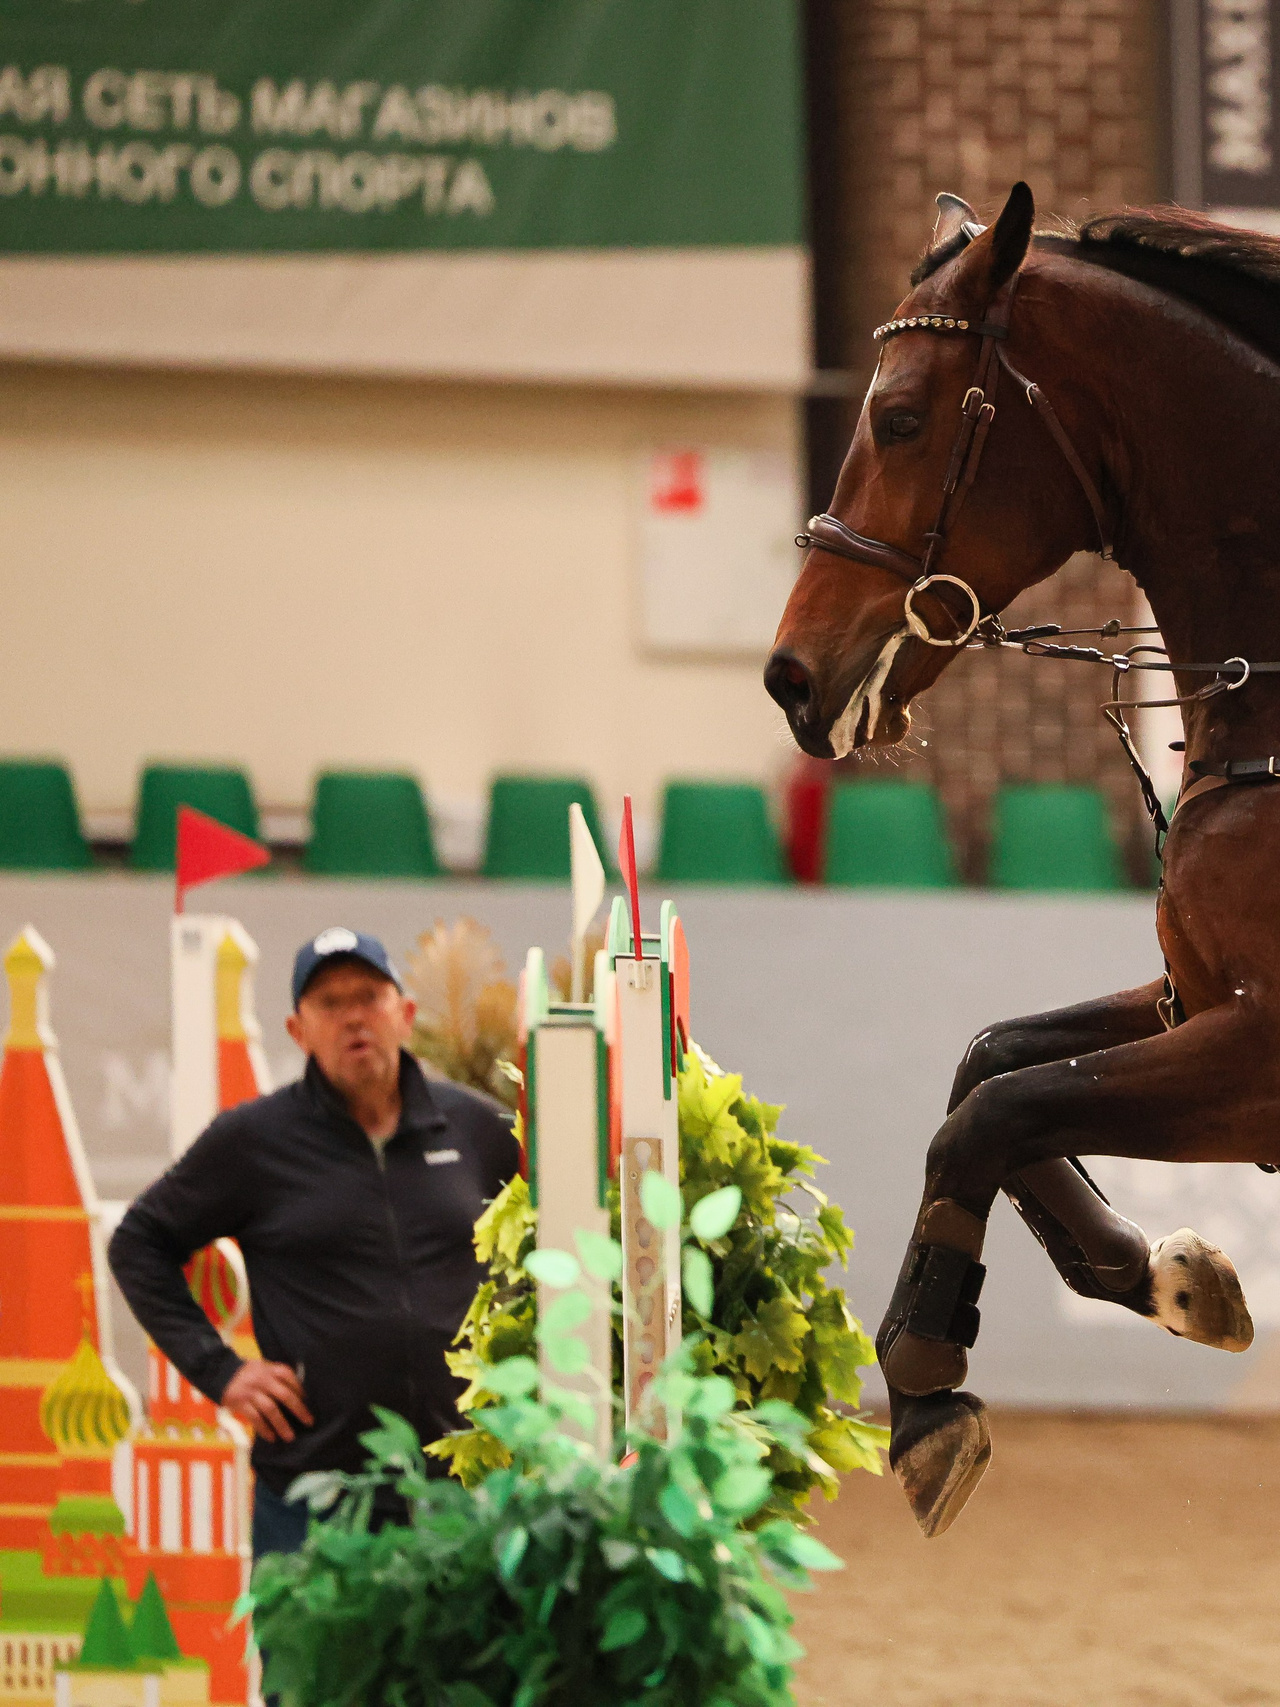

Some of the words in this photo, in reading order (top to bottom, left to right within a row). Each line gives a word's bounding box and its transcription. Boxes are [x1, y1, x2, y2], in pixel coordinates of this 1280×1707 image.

[83, 67, 241, 134] СЕТЬ
[251, 76, 617, 151] МАГАЗИНОВ
[251, 147, 495, 217] СПОРТА
